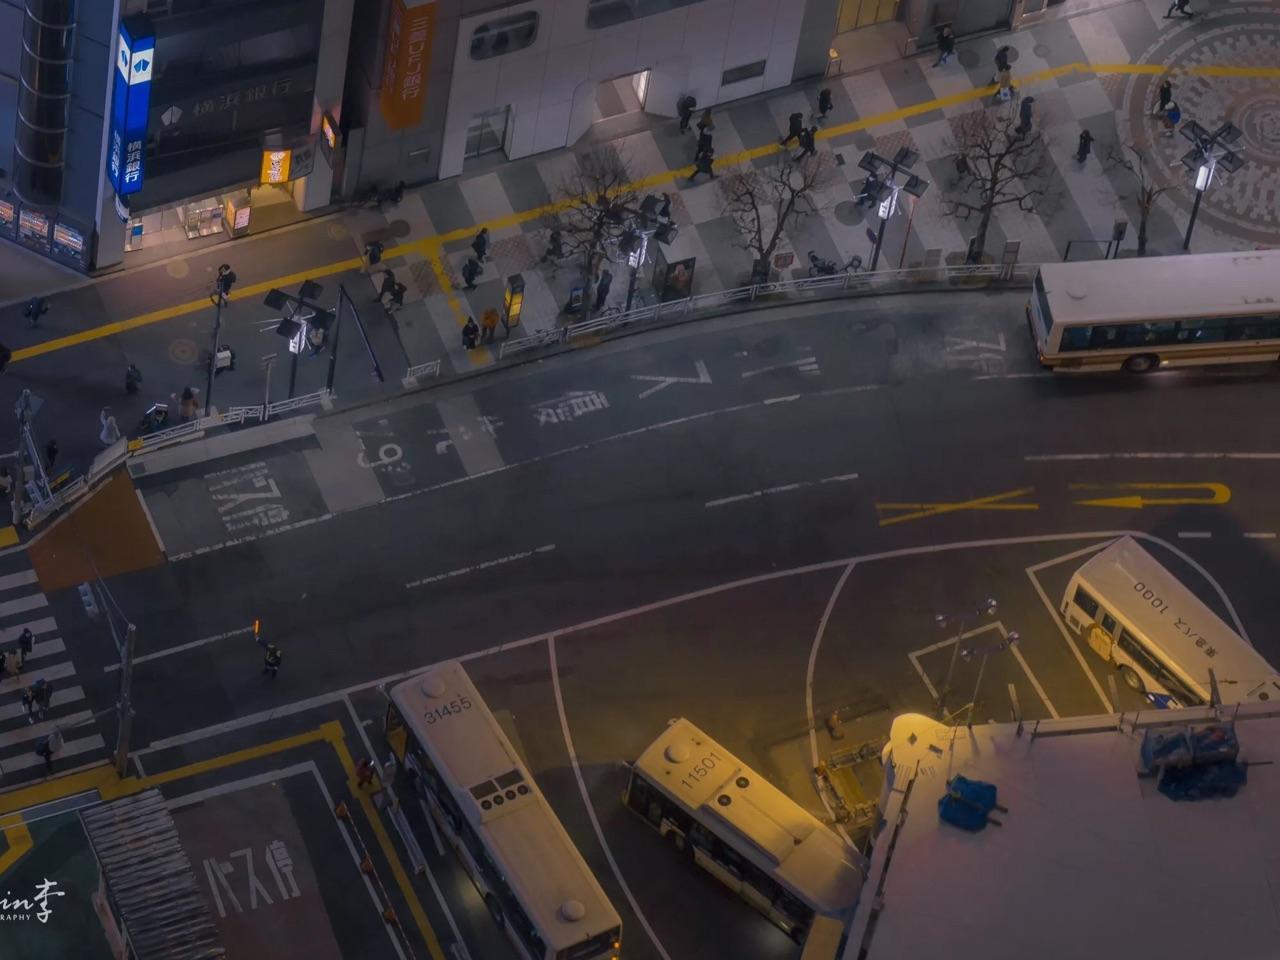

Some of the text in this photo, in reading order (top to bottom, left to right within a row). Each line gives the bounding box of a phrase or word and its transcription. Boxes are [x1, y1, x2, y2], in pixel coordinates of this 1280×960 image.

[124, 140, 142, 183] 横浜銀行
[424, 696, 473, 725] 31455
[681, 751, 722, 791] 11501
[202, 839, 302, 919] バス停
